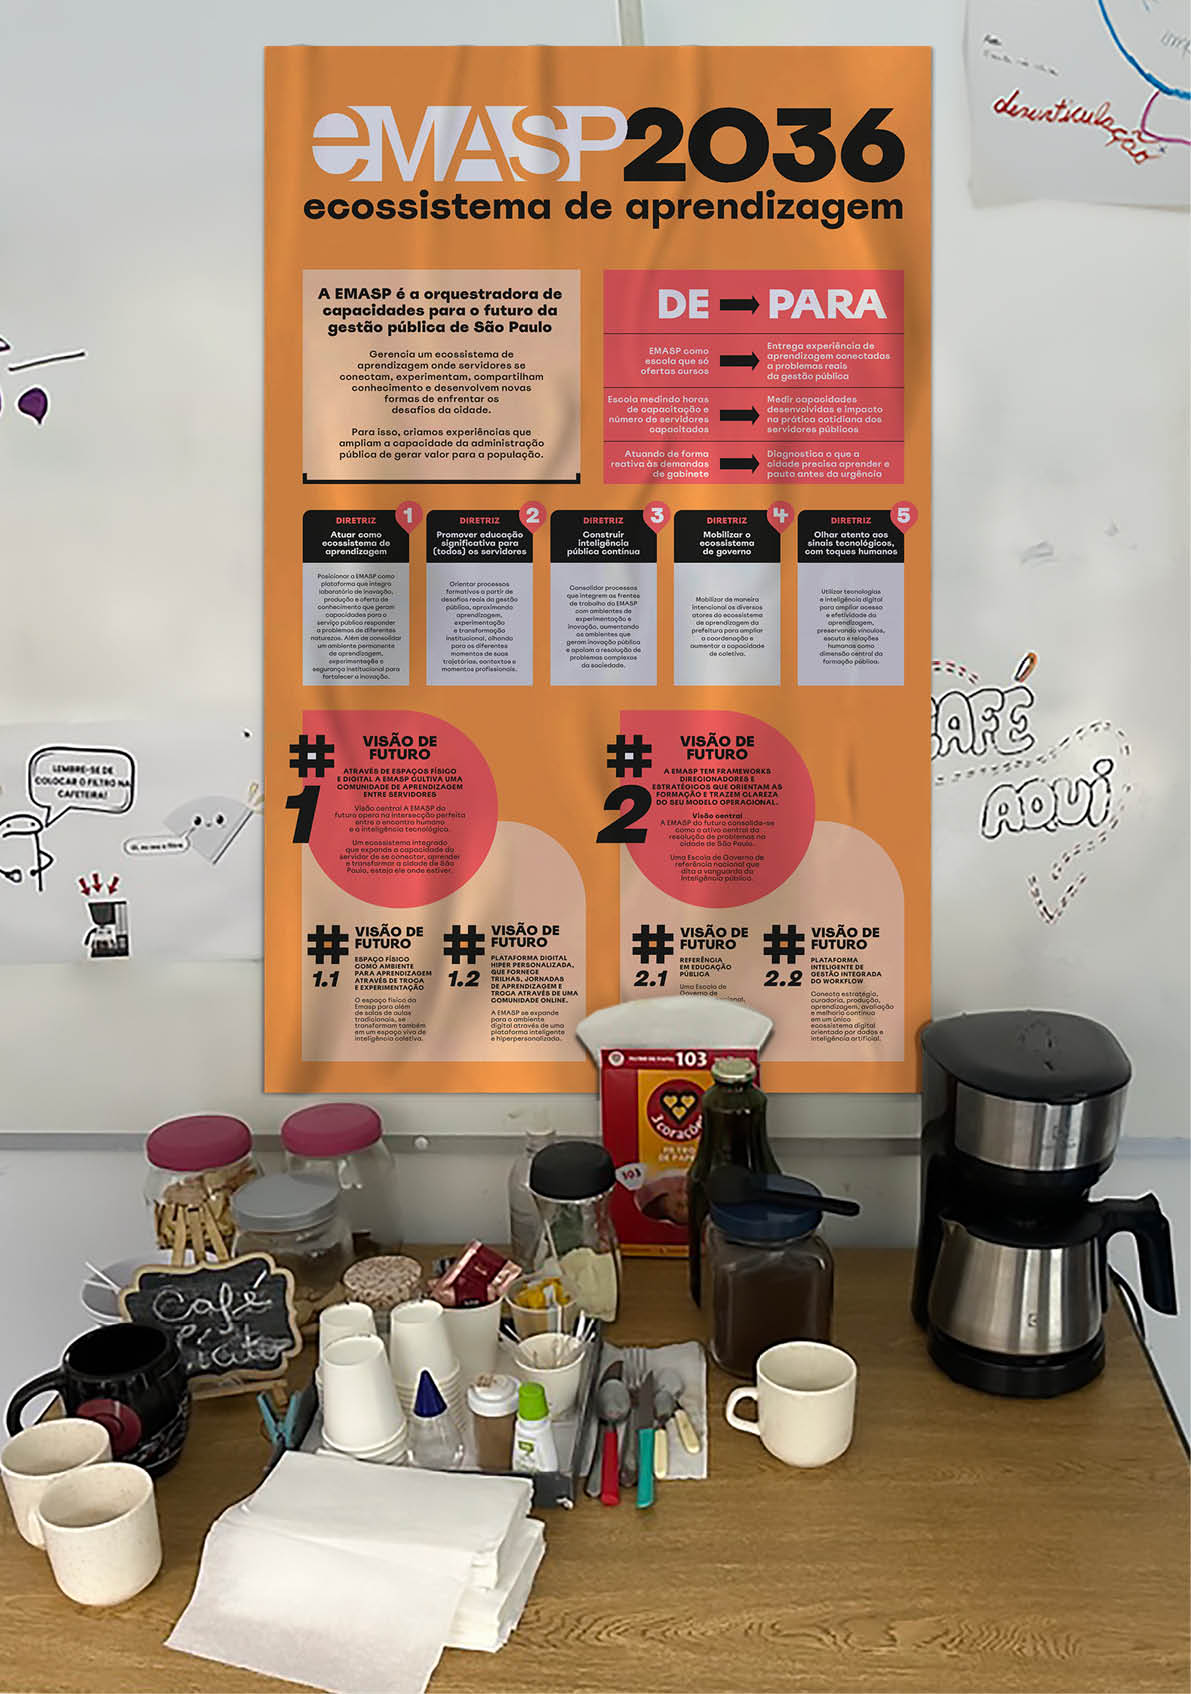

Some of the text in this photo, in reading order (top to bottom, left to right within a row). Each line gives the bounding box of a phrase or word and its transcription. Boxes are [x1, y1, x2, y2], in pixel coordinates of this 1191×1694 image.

[304, 189, 903, 230] ecossistema de aprendizagem
[318, 287, 562, 303] A EMASP é a orquestradora de
[658, 289, 709, 319] DE
[769, 289, 887, 319] PARA
[323, 303, 558, 320] capacidades para o futuro da
[328, 320, 552, 336] gestão pública de São Paulo
[649, 346, 682, 355] EMASP
[767, 342, 875, 352] Entrega experiência de
[369, 350, 416, 358] Gerencia
[434, 350, 499, 358] ecossistema
[501, 350, 514, 358] de
[767, 351, 890, 362] aprendizagem conectadas
[357, 360, 429, 371] aprendizagem
[431, 361, 456, 370] onde
[458, 360, 512, 370] servidores
[645, 356, 709, 367] escola que só
[775, 362, 824, 372] problemas
[824, 362, 848, 370] reais
[640, 367, 676, 375] ofertas
[339, 372, 544, 382] conectam, experimentam, compartilham
[767, 372, 849, 382] da gestão pública
[351, 383, 424, 392] conhecimento
[434, 383, 500, 392] desenvolvem
[384, 394, 420, 403] formas
[422, 394, 435, 403] de
[437, 394, 485, 403] enfrentar
[391, 405, 492, 414] desafios da cidade.
[403, 508, 412, 523] 1
[526, 507, 540, 523] 2
[650, 508, 664, 523] 3
[773, 507, 788, 523] 4
[897, 508, 910, 523] 5
[480, 530, 524, 539] educação
[582, 530, 624, 538] Construir
[703, 530, 743, 538] Mobilizar
[322, 539, 390, 547] ecossistema de
[441, 539, 519, 548] significativa para
[578, 539, 629, 548] inteligência
[699, 539, 755, 547] ecossistema
[807, 539, 895, 548] sinais tecnológicos,
[325, 547, 387, 556] aprendizagem
[481, 547, 527, 555] servidores
[566, 546, 600, 557] pública
[716, 549, 752, 557] governo
[825, 548, 856, 557] toques
[858, 547, 898, 555] humanos
[362, 732, 437, 747] VISÃO DE
[680, 732, 755, 747] VISÃO DE
[369, 748, 431, 760] FUTURO
[687, 748, 748, 760] FUTURO
[285, 786, 320, 843] 1
[596, 785, 652, 843] 2
[355, 923, 424, 937] VISÃO DE
[491, 922, 560, 936] VISÃO DE
[680, 924, 748, 938] VISÃO DE
[811, 924, 880, 938] VISÃO DE
[355, 938, 412, 949] FUTURO
[491, 937, 548, 948] FUTURO
[680, 939, 736, 950] FUTURO
[811, 939, 868, 950] FUTURO
[680, 964, 690, 972] EM
[313, 971, 340, 987] 1.1
[448, 970, 480, 987] 1.2
[634, 970, 668, 987] 2.1
[676, 1052, 707, 1066] 103
[153, 1269, 272, 1335] Café
